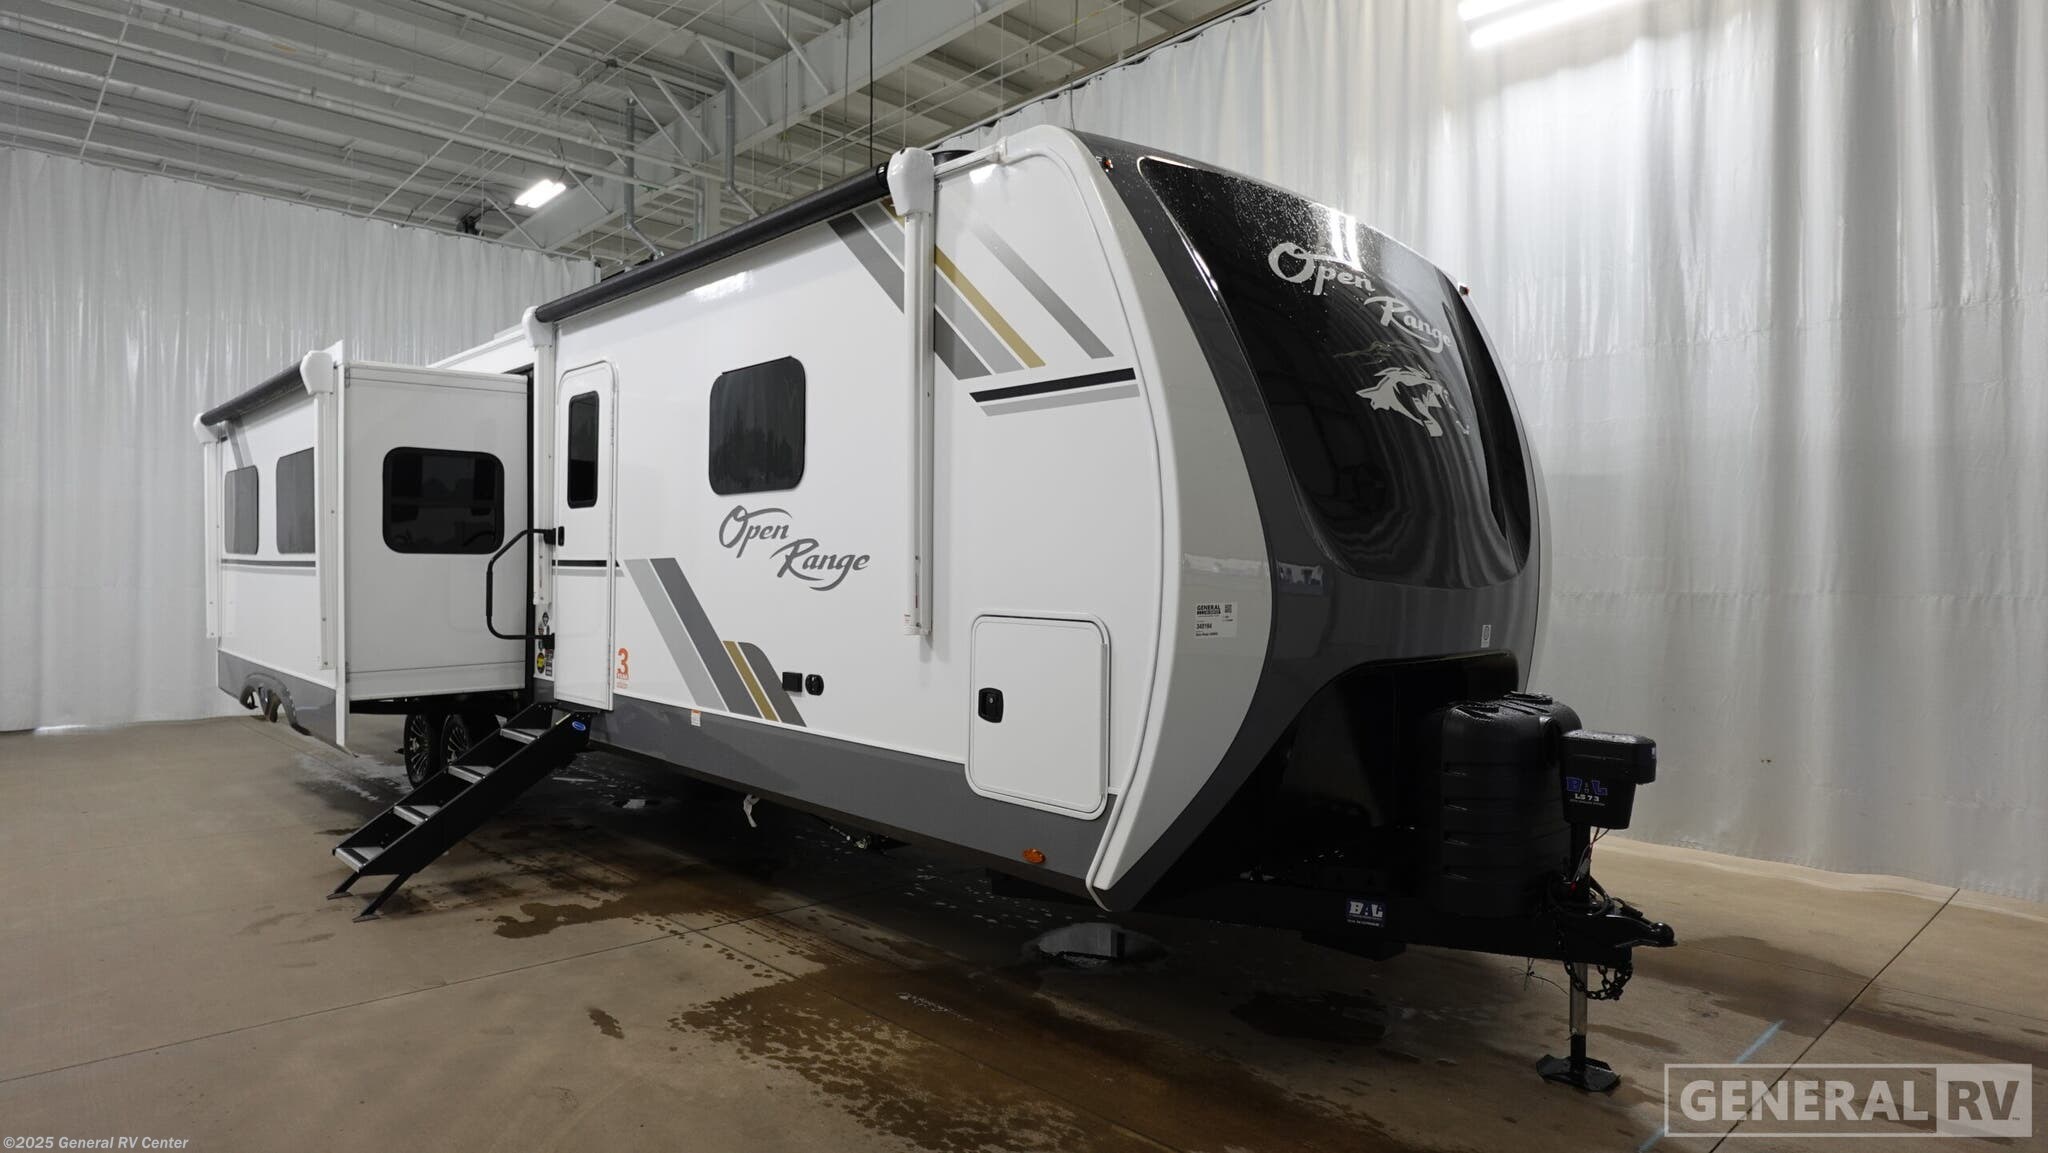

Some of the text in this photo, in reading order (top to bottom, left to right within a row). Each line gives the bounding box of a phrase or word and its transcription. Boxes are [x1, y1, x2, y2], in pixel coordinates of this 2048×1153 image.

[1268, 242, 1375, 295] Open
[1364, 296, 1452, 354] Range
[719, 505, 792, 558] Open
[769, 538, 870, 591] Range
[617, 647, 629, 674] 3
